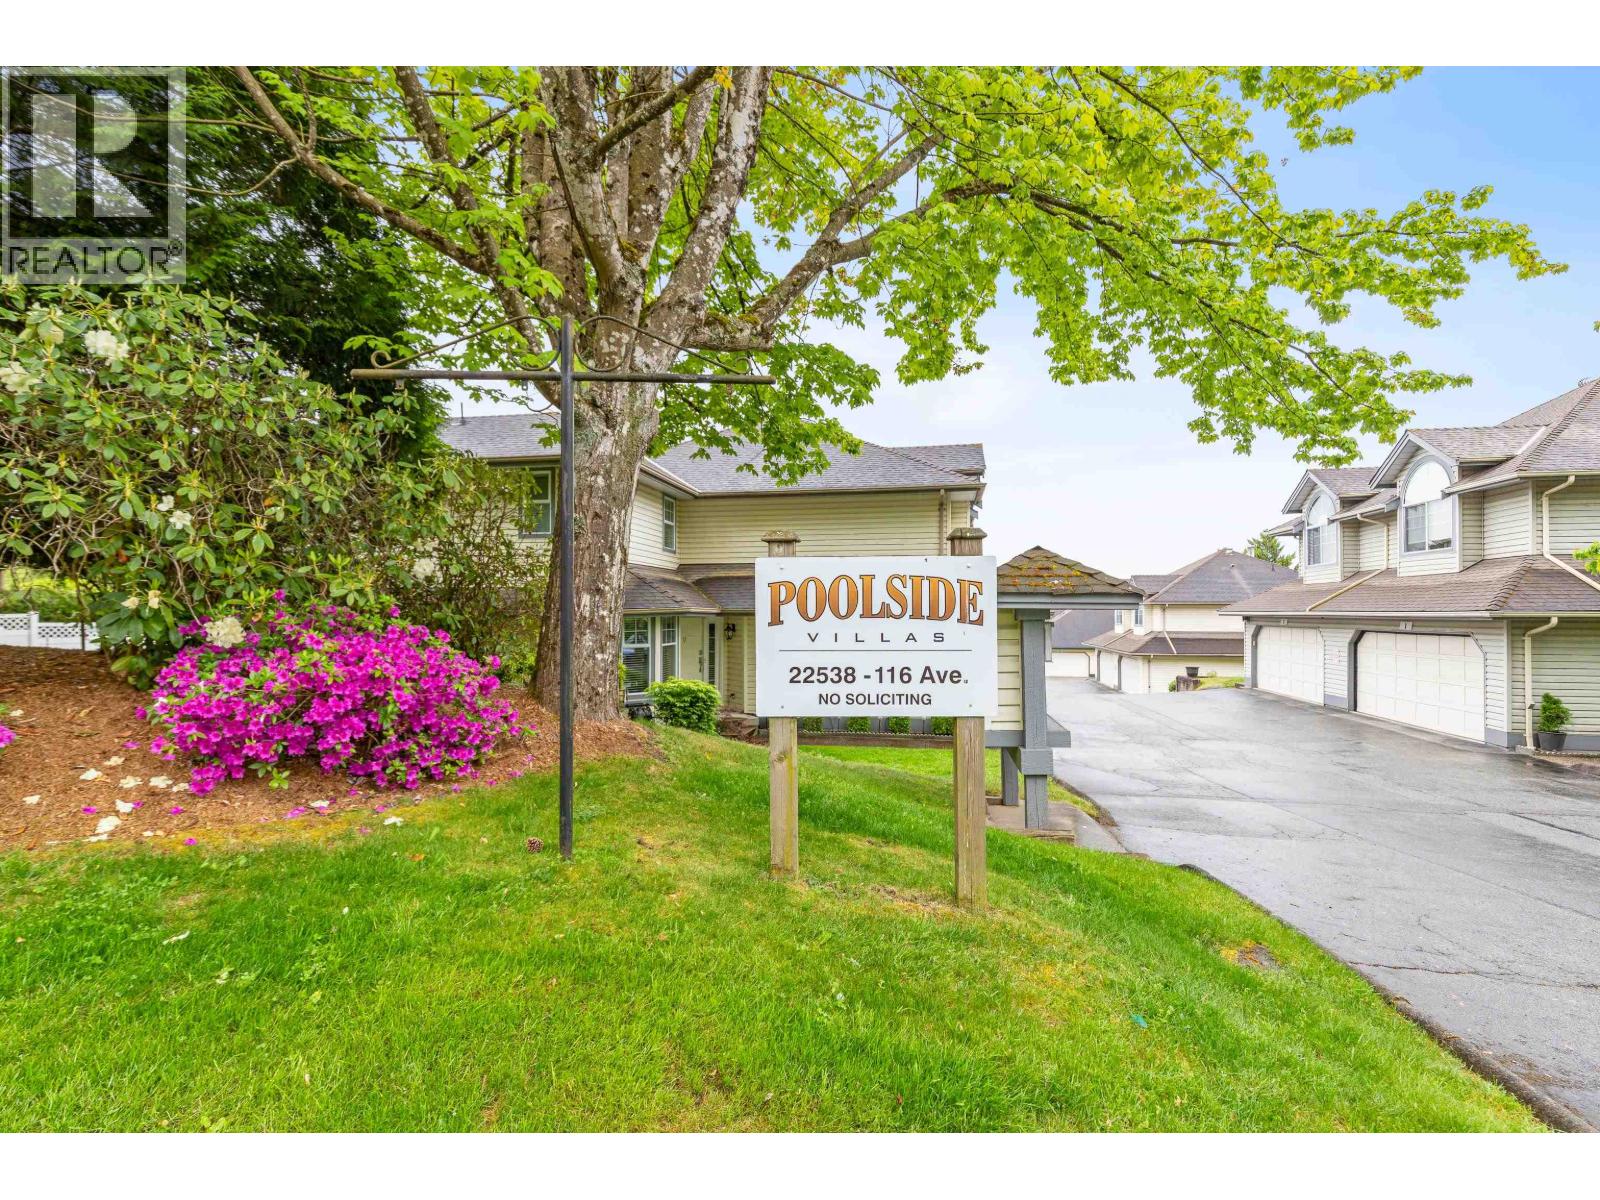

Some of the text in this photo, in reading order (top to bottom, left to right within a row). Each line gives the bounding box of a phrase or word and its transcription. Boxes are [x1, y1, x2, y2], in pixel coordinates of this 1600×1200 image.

[767, 574, 984, 627] POOLSIDE
[807, 632, 945, 643] VILLAS
[789, 666, 857, 684] 22538
[818, 693, 932, 706] NO SOLICITING
